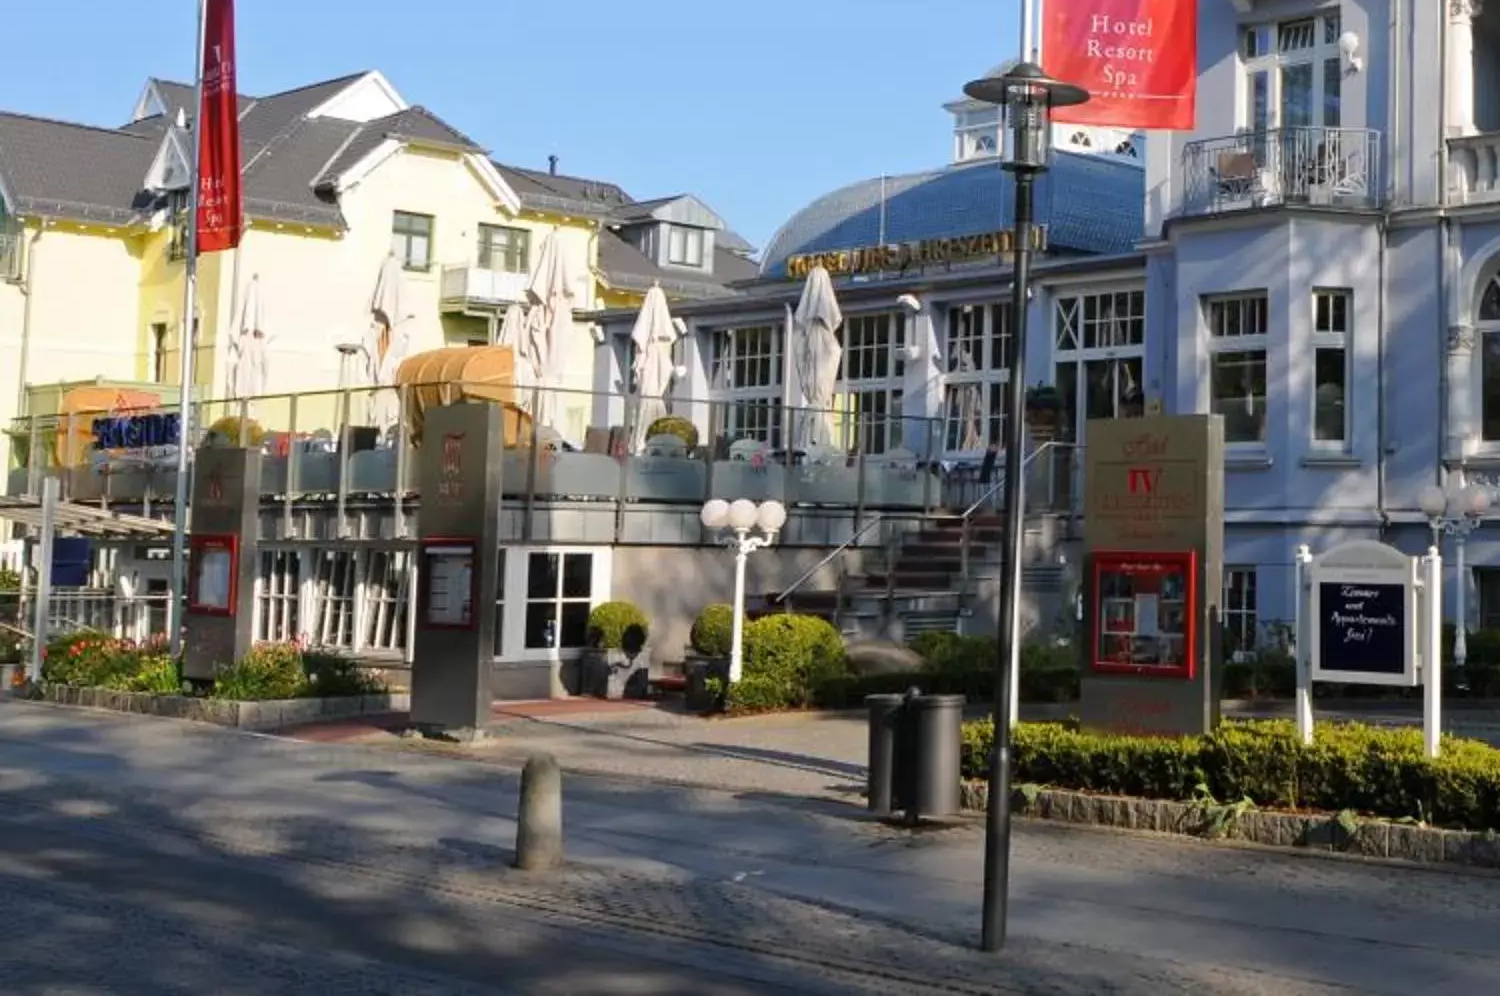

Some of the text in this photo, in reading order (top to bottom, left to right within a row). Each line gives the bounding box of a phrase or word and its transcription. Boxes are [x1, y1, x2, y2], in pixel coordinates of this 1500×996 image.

[1091, 14, 1153, 37] Hotel
[1087, 38, 1153, 63] Resort
[1103, 63, 1137, 90] Spa
